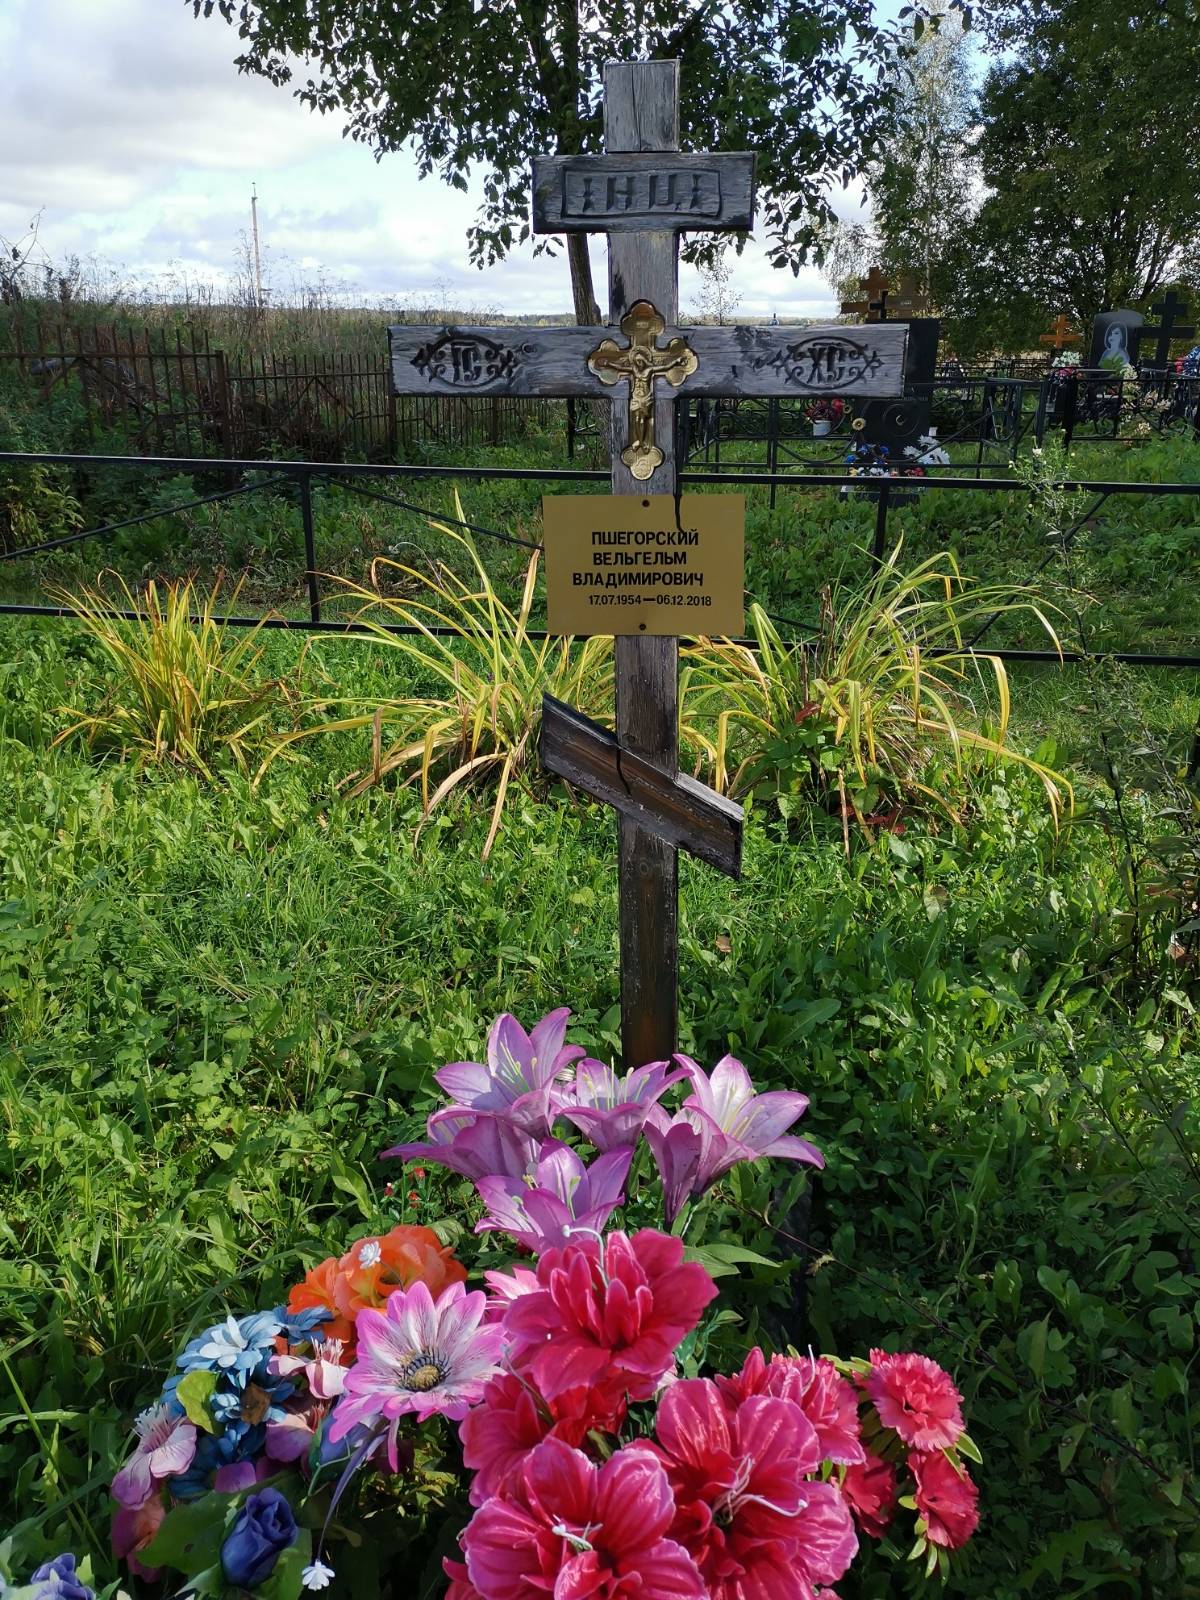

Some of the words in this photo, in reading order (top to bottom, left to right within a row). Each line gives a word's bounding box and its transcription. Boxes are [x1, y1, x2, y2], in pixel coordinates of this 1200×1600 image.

[591, 529, 699, 546] ПШЕГОРСКИЙ
[593, 551, 687, 566] ВЕЛЬГЕЛЬМ
[572, 572, 704, 589] ВЛАДИМИРОВИЧ
